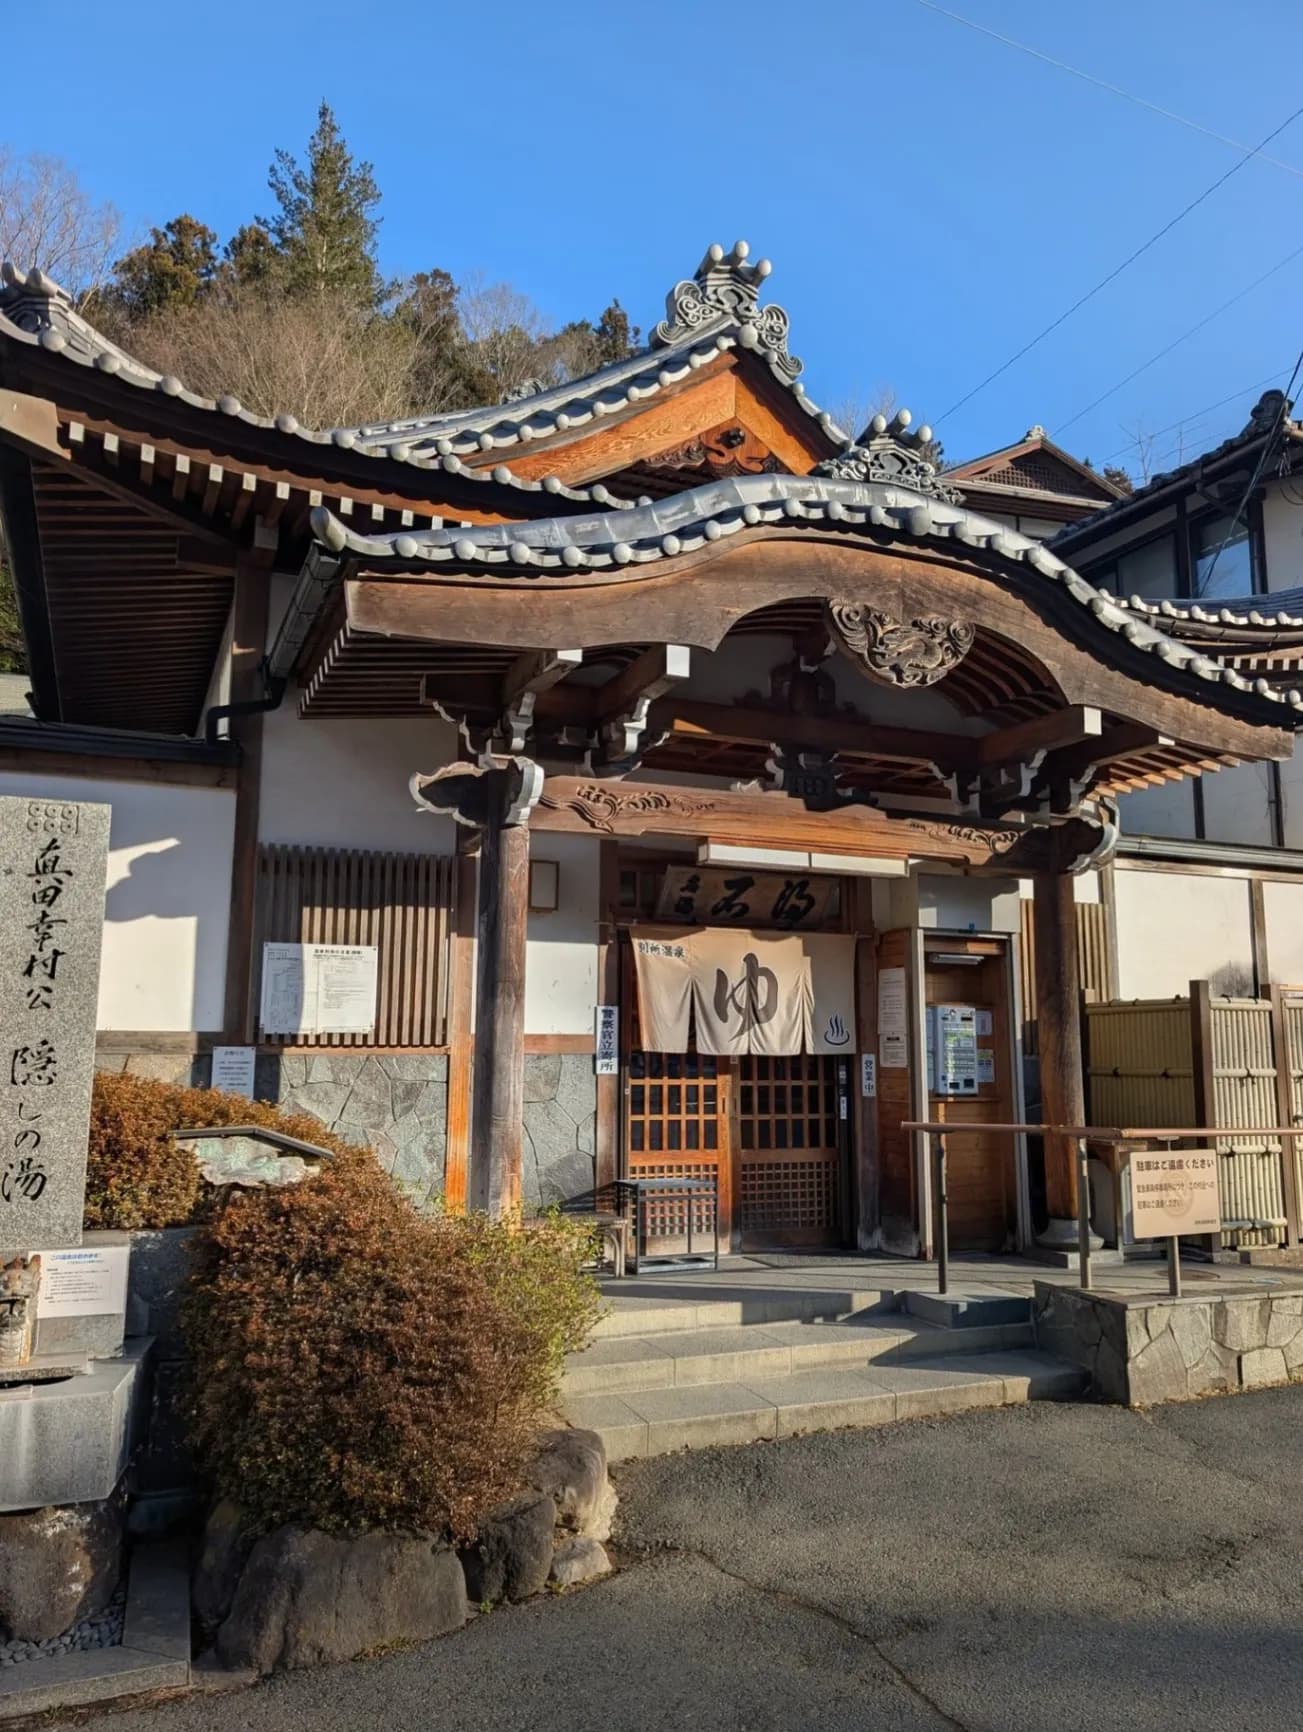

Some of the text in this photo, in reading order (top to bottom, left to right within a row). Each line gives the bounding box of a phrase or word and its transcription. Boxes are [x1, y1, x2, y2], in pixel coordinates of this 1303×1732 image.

[638, 942, 685, 958] 別所温泉
[713, 953, 778, 1043] ゆ
[600, 1008, 615, 1072] 警察官立寄所
[1135, 1158, 1214, 1172] 駐車はご遠慮ください
